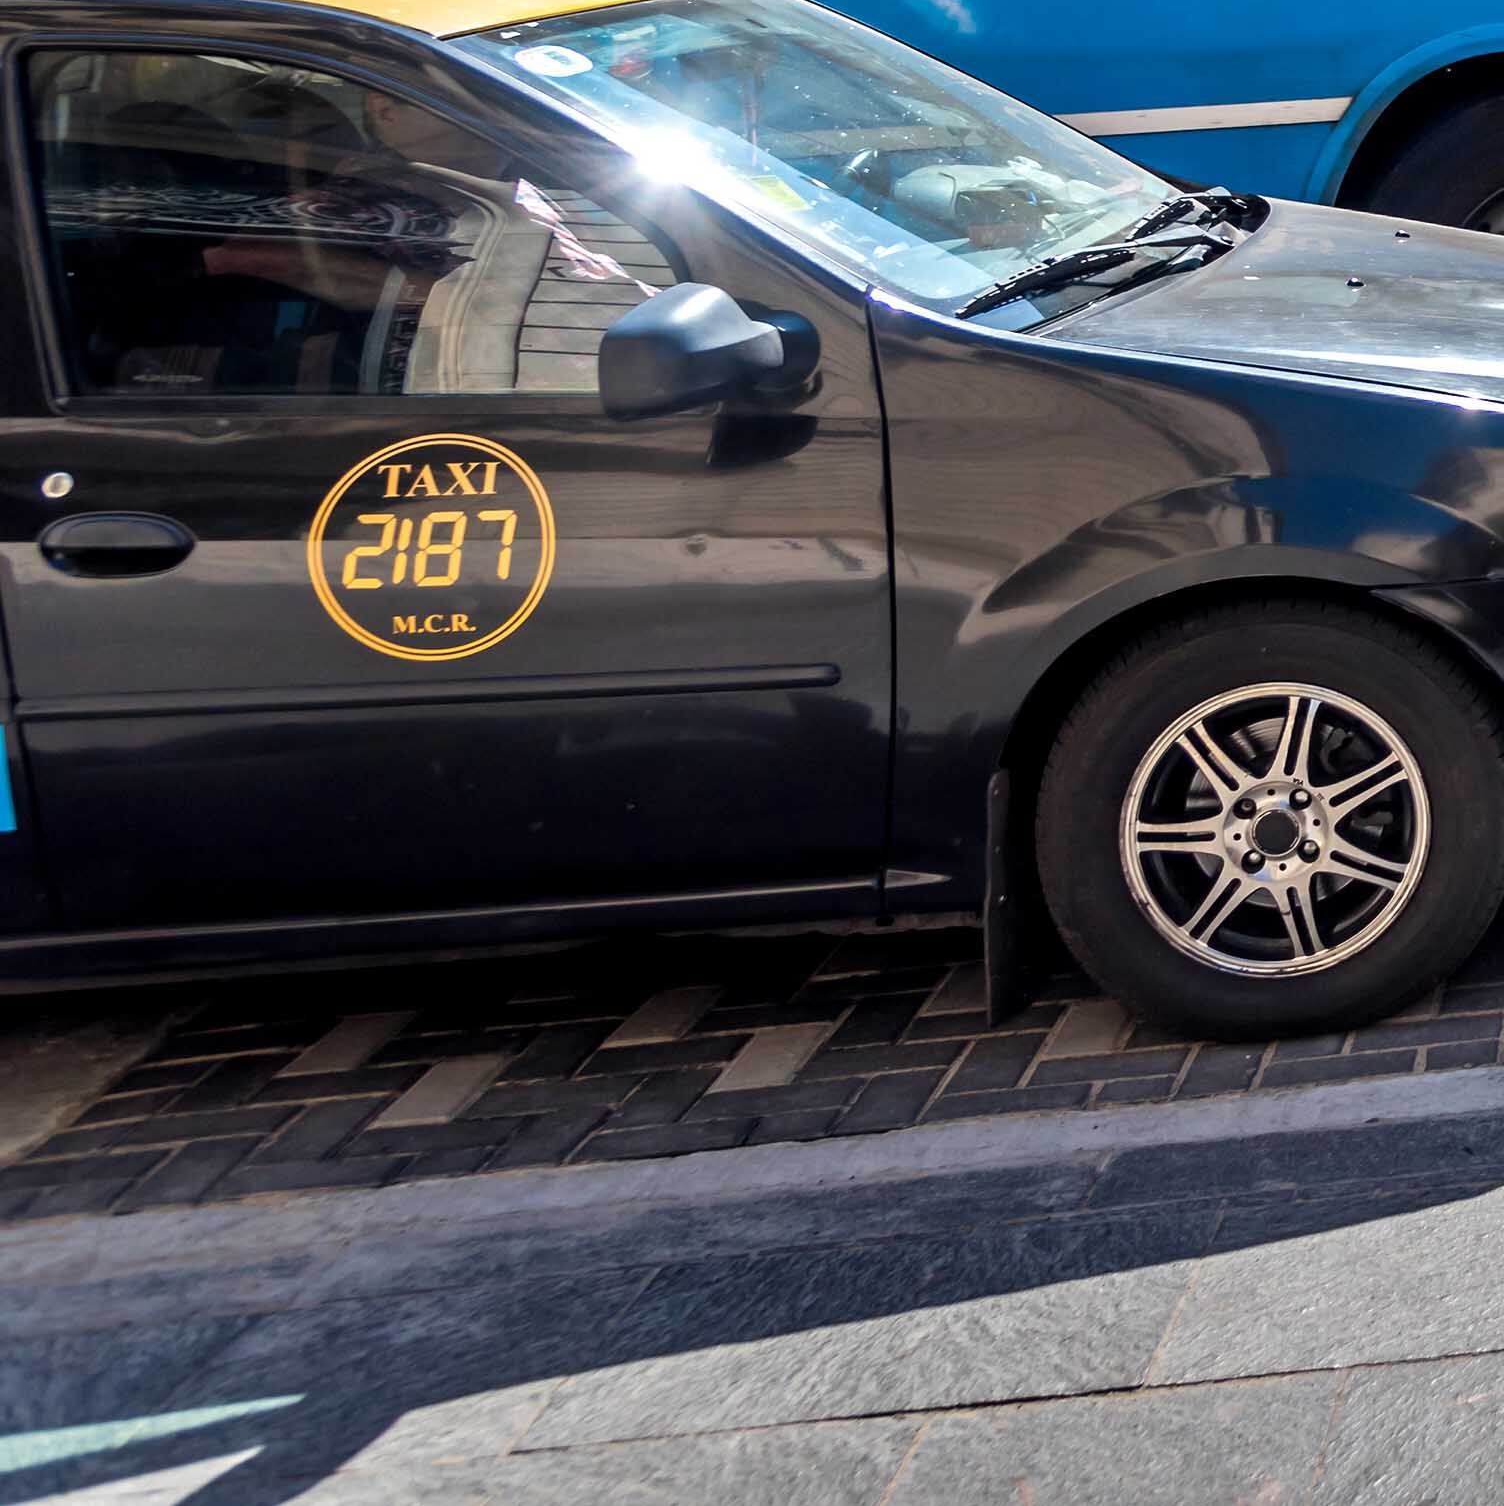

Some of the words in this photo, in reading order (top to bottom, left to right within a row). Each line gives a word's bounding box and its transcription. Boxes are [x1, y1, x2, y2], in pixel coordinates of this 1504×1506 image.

[377, 461, 501, 498] TAXI
[341, 509, 518, 589] 2187
[392, 613, 477, 634] M.C.R.
